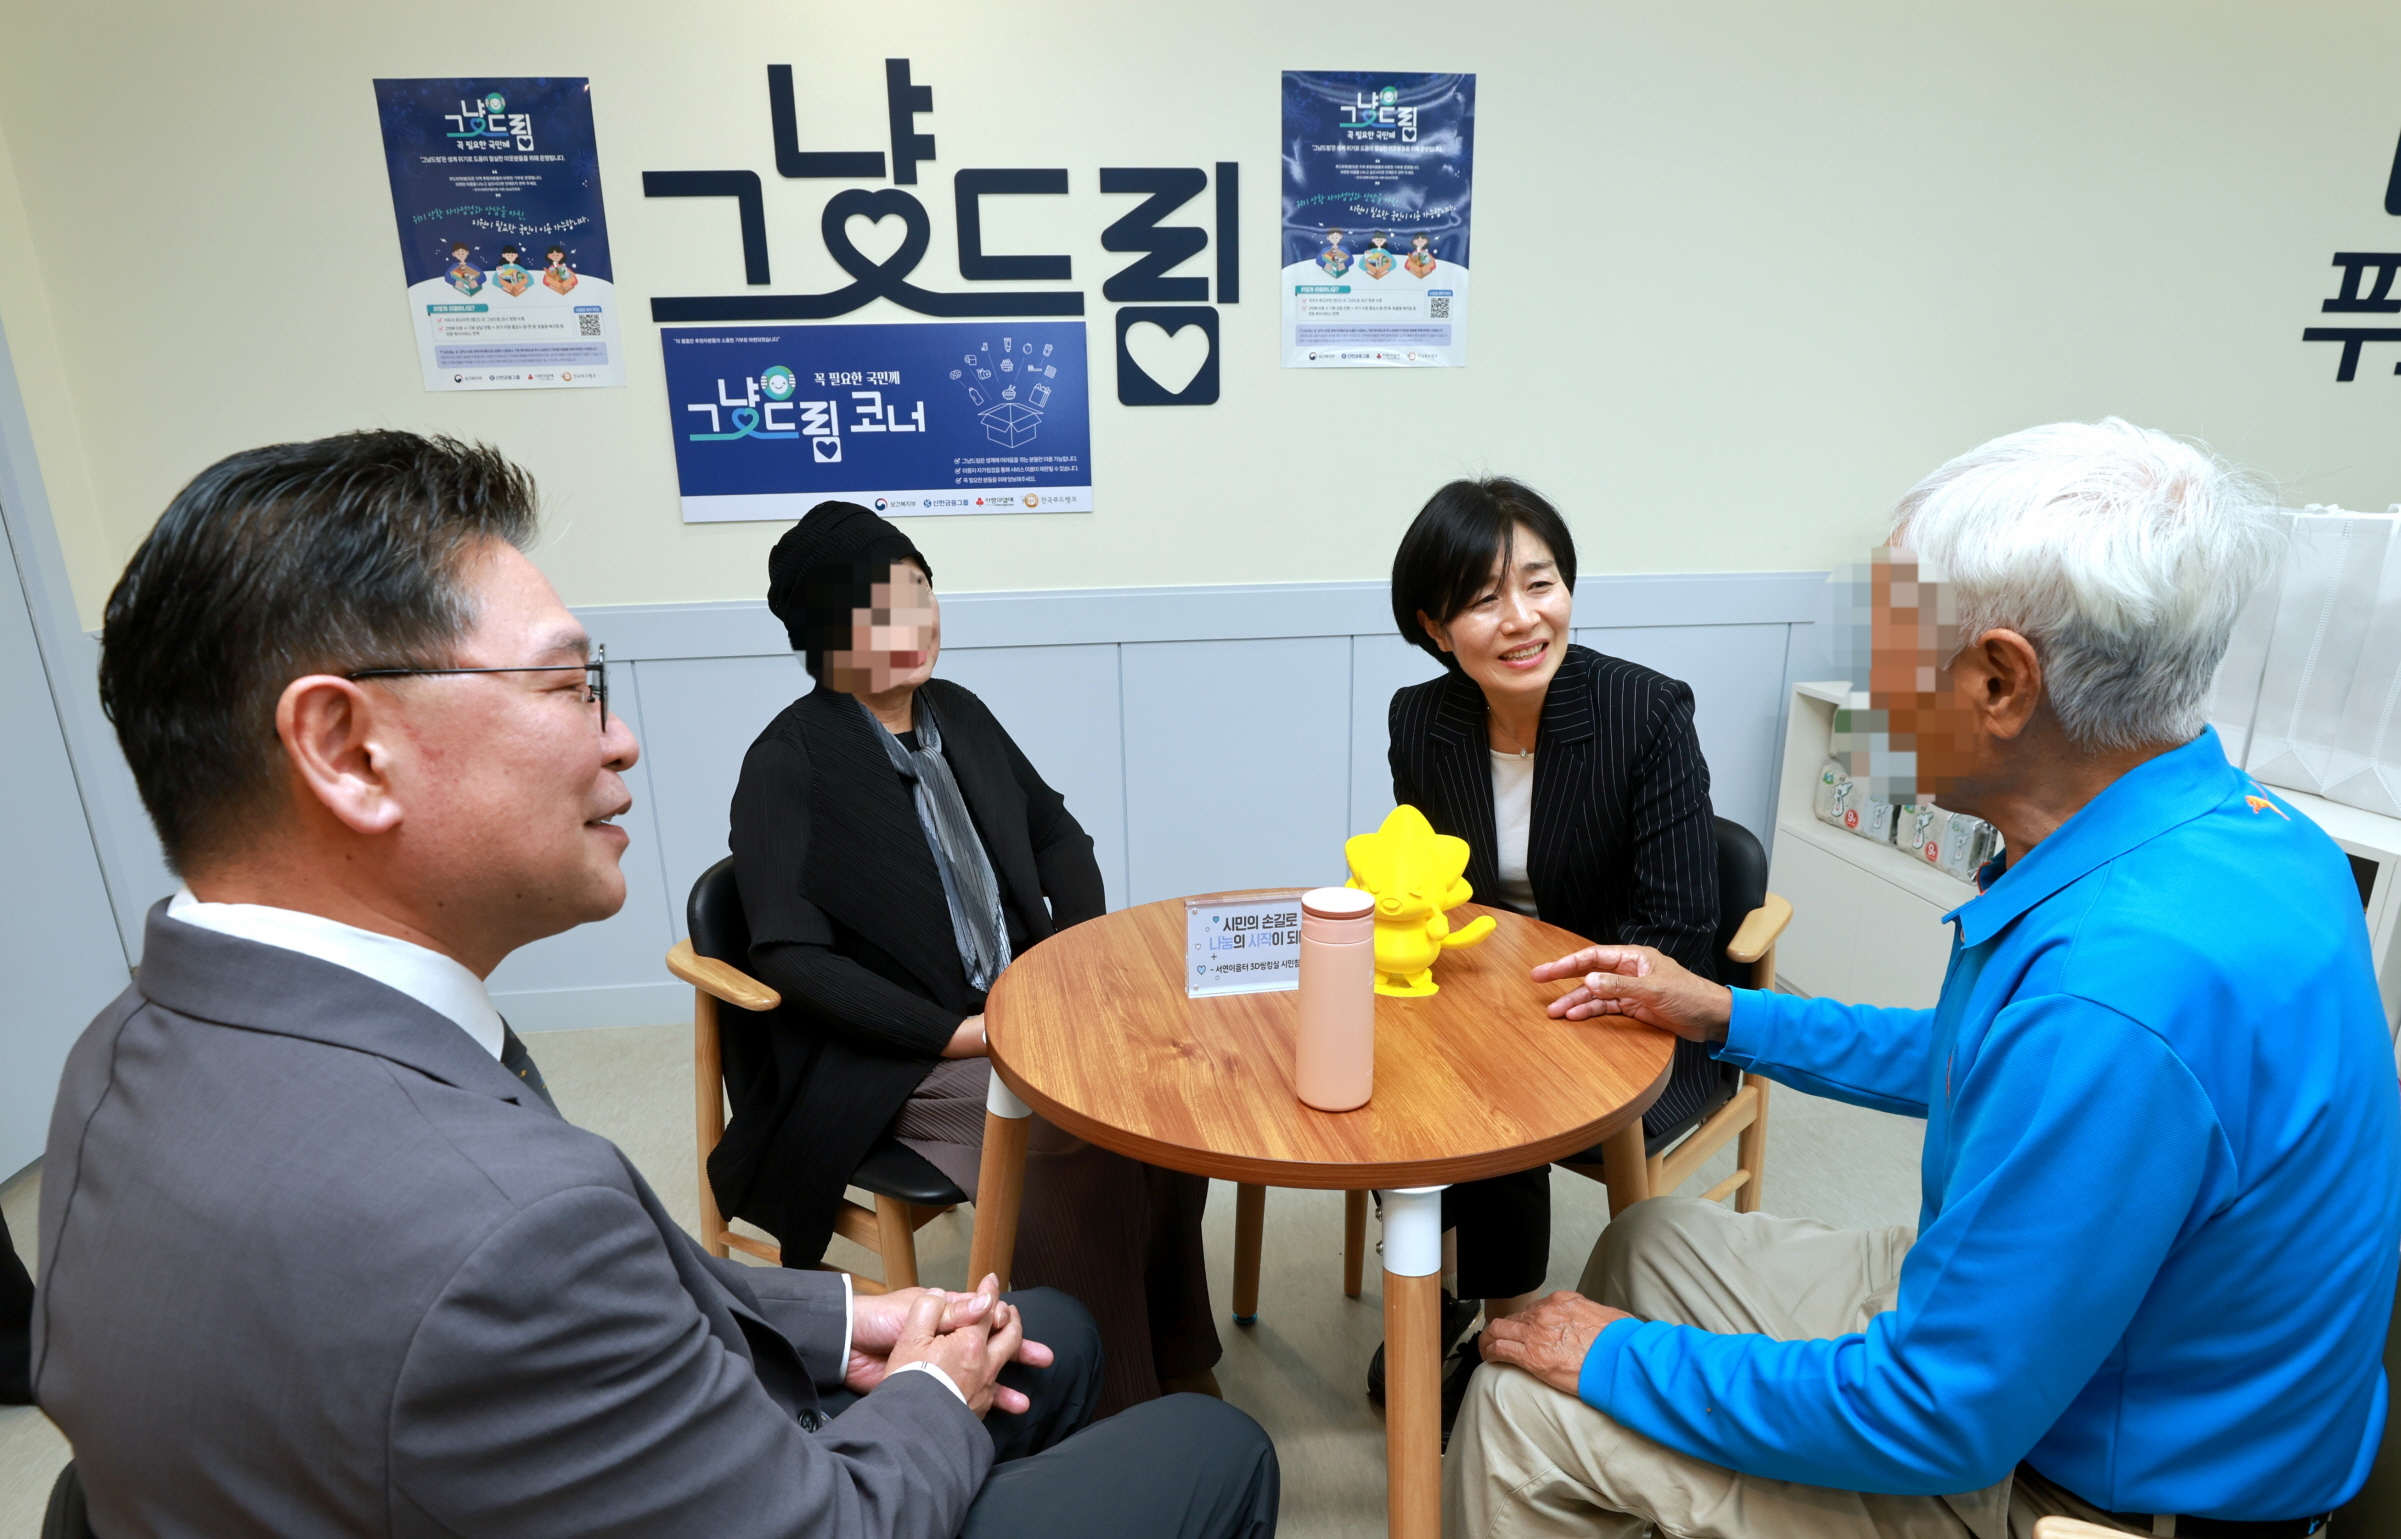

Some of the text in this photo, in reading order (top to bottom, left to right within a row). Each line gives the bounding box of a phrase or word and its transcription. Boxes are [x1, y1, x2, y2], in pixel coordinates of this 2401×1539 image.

[445, 97, 534, 151] 그냥드림
[1340, 91, 1418, 142] 그냥드림
[1347, 131, 1396, 140] 꼭 필요한 국민께
[456, 140, 510, 150] 꼭 필요한 국민께
[1370, 206, 1389, 220] 필요한
[472, 218, 493, 229] 지원이
[495, 220, 516, 234] 필요한
[519, 224, 537, 236] 국민이
[642, 58, 1240, 406] 그냥드림
[2303, 252, 2401, 382] 푸
[814, 370, 900, 386] 꼭 필요한 국민께
[688, 376, 926, 463] 그냥드림 코너
[932, 499, 969, 507] 신한금융그룹
[1040, 495, 1077, 504] 전국푸드뱅크
[1222, 913, 1298, 932] 시민의 손길로
[1209, 930, 1302, 950] 나눔의 시작이 되
[1215, 963, 1248, 974] 서연이음터
[1250, 960, 1279, 972] 3D씽킹실
